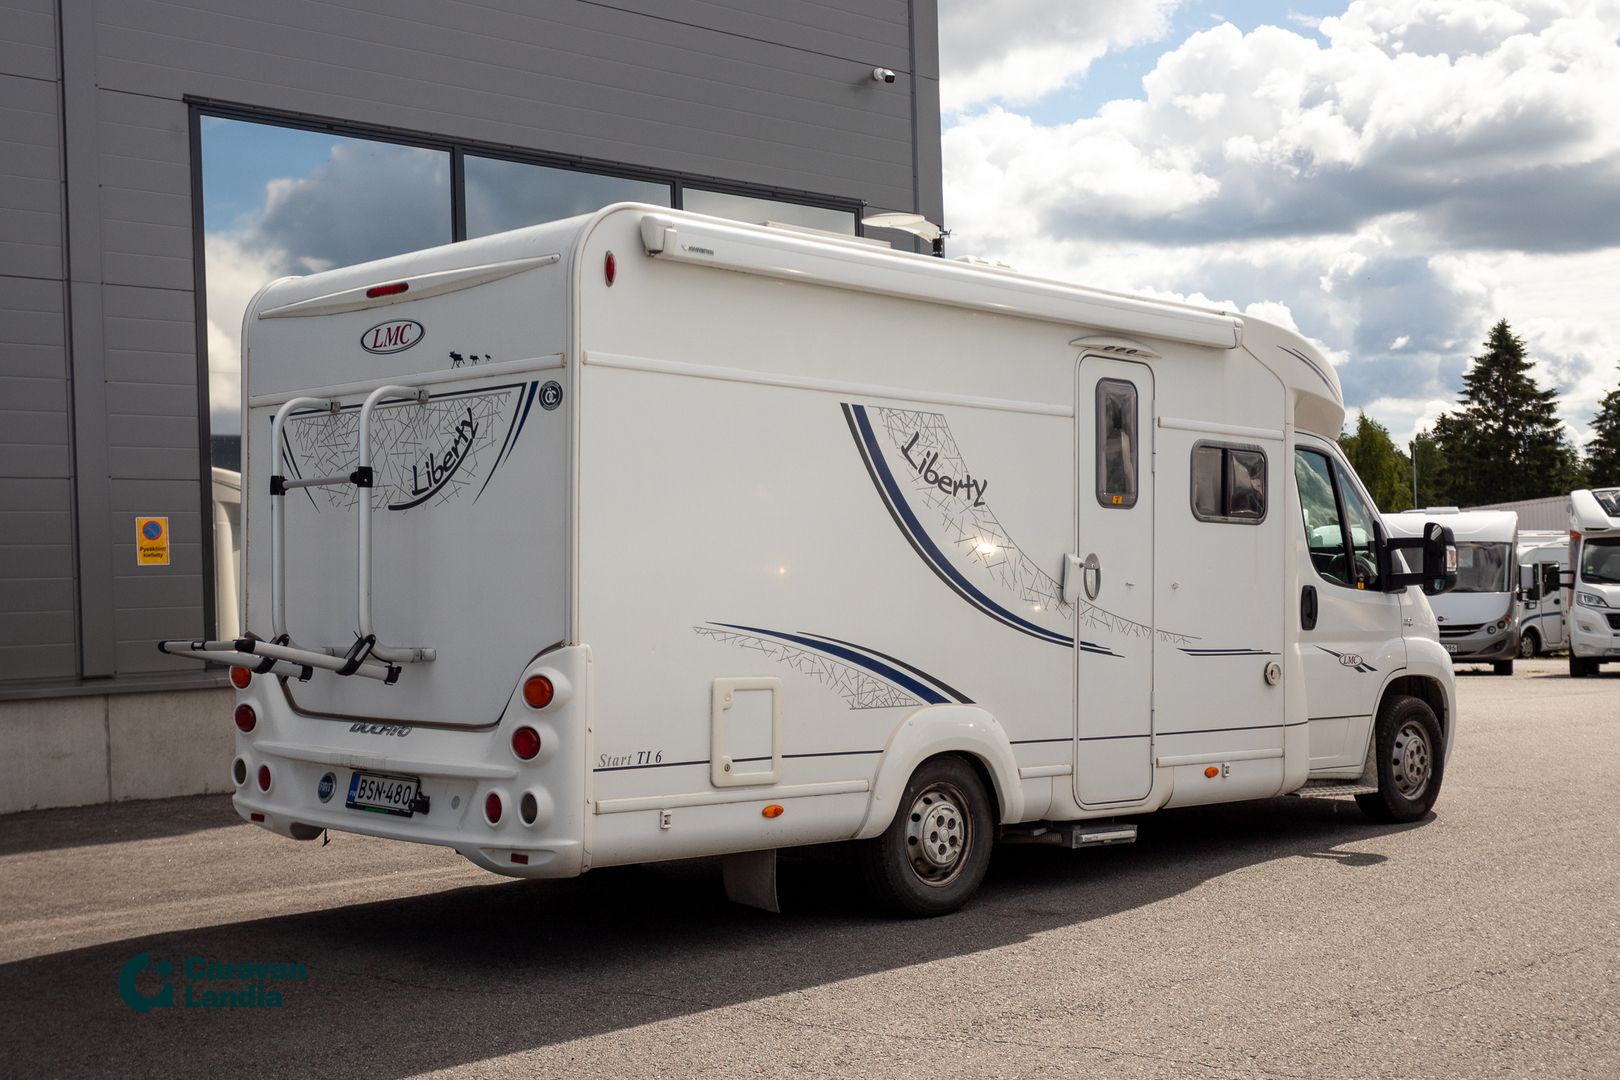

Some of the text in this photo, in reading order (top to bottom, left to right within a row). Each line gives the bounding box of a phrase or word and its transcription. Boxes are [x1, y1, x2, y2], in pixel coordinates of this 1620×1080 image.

[372, 323, 412, 349] LMC
[411, 407, 479, 496] Liberty
[901, 431, 988, 508] Liberty
[598, 750, 662, 768] Start TI 6
[358, 779, 412, 806] BSN-480
